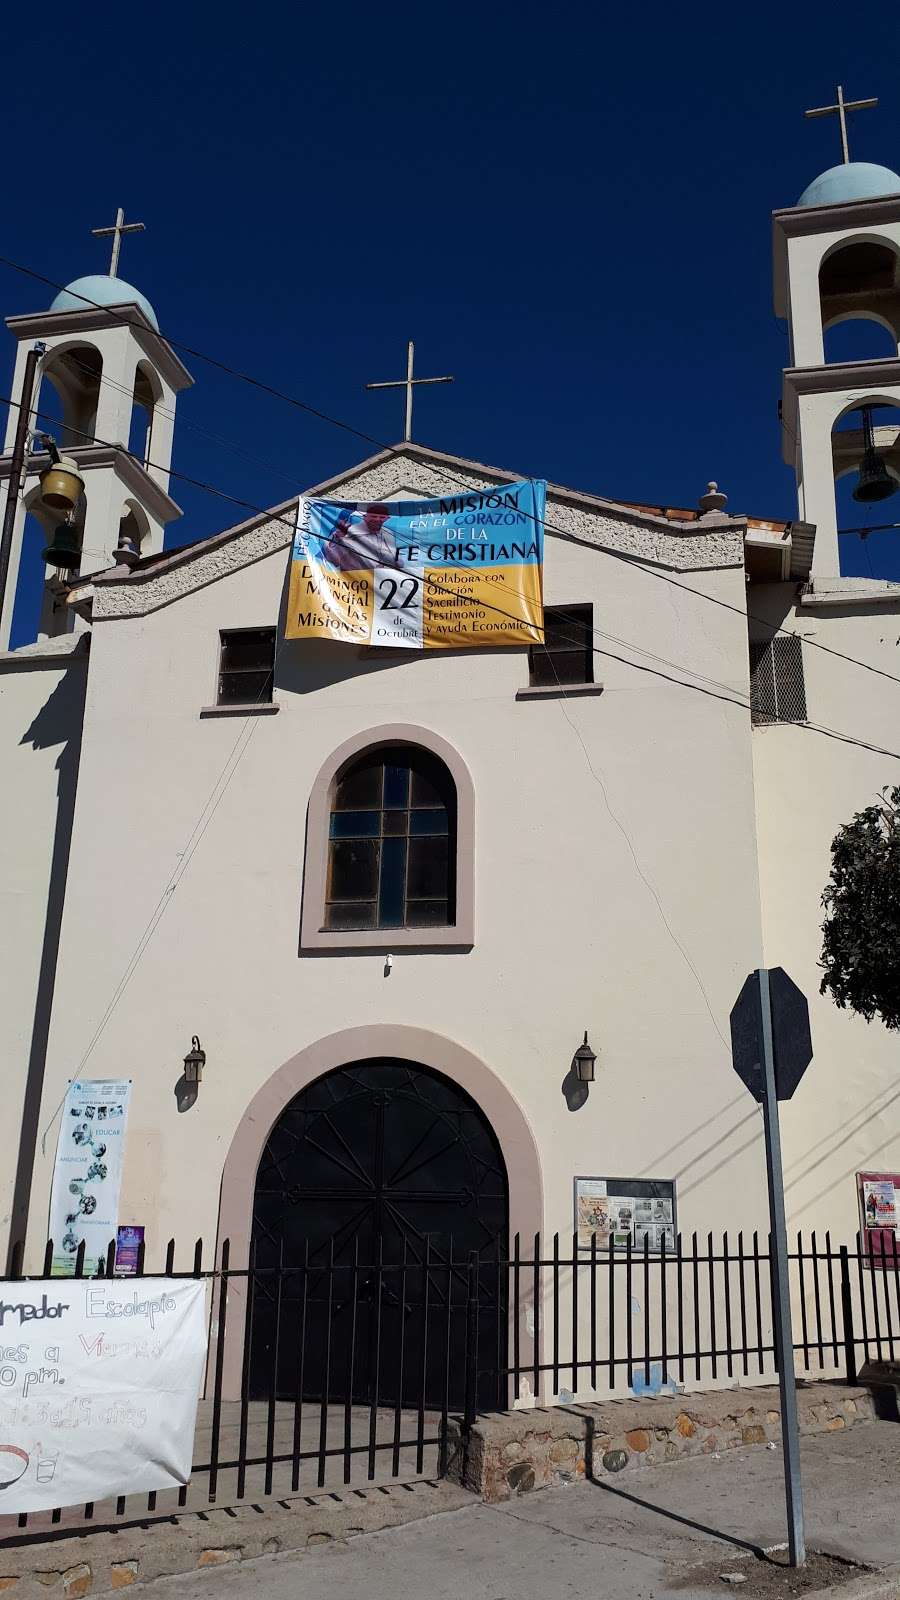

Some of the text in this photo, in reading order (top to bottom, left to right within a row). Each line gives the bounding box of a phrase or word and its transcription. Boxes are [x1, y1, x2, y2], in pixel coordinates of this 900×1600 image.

[440, 489, 520, 516] MISIÓN
[409, 510, 527, 528] EN EL CORAZÓN
[446, 528, 488, 540] DE LA
[395, 542, 539, 562] FE CRISTIANA
[379, 578, 420, 610] 22
[86, 1288, 177, 1330] Escolapio
[22, 1367, 66, 1398] pm.
